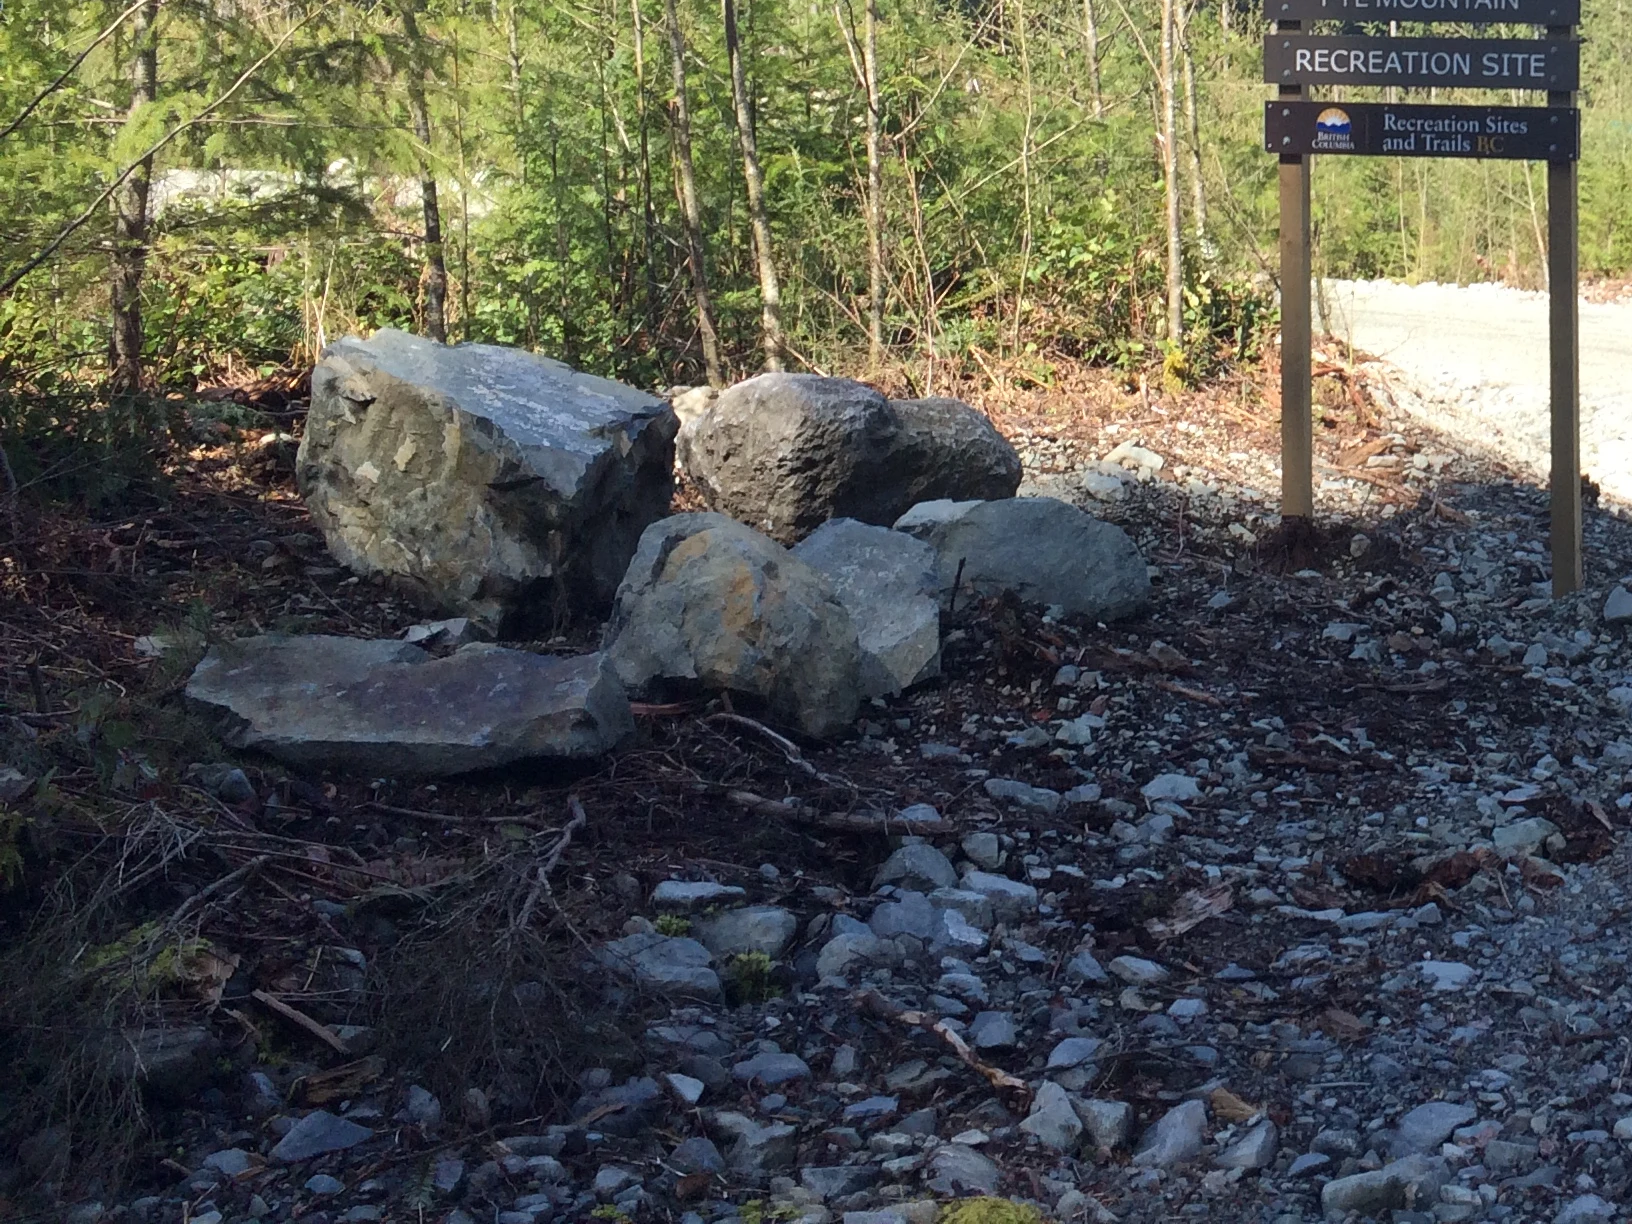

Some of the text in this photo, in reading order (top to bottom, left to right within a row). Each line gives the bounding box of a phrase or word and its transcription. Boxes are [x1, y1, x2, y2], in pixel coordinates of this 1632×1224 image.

[1295, 49, 1545, 77] RECREATION SITE
[1383, 113, 1528, 134] Recreation Sites
[1383, 133, 1504, 154] and Trails BC
